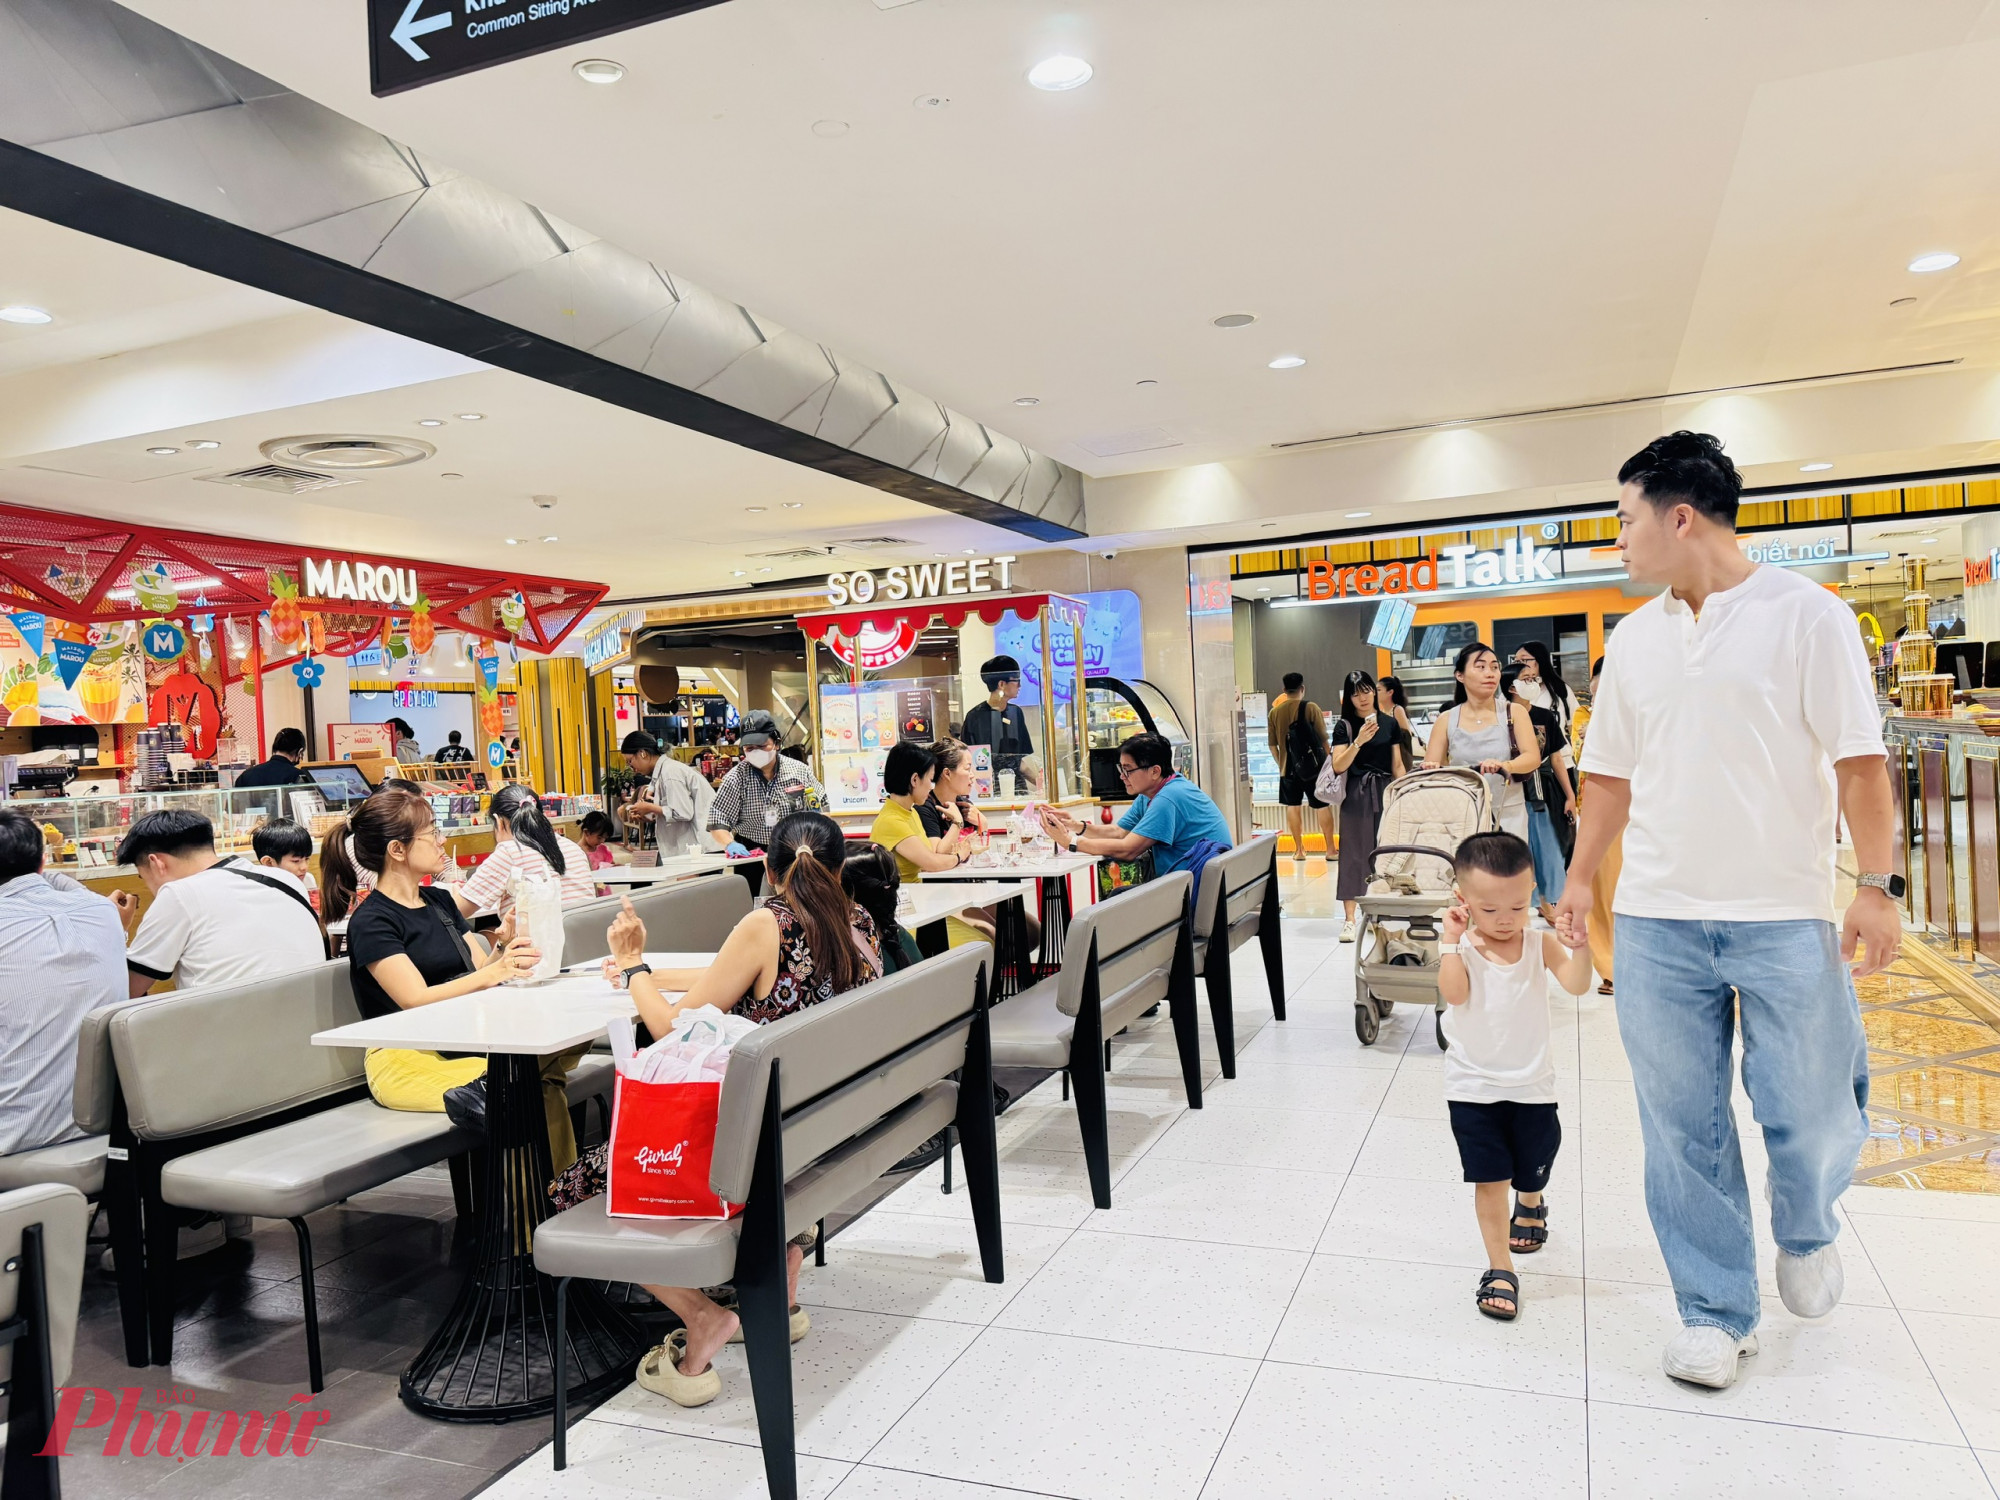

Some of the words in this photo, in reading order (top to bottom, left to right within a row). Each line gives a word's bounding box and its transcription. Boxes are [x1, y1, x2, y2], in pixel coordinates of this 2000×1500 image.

[466, 11, 526, 38] Common
[528, 0, 571, 21] Sitting
[1747, 538, 1792, 563] biết
[1798, 538, 1836, 559] nói
[306, 557, 418, 606] MAROU
[827, 571, 877, 606] SO
[887, 555, 1017, 600] SWEET
[18, 614, 40, 623] MAISON
[20, 621, 42, 631] MAROU
[61, 646, 86, 655] MAISON
[153, 631, 175, 652] M
[584, 626, 623, 669] HIGHLANDS
[60, 653, 85, 663] MAROU
[1054, 644, 1103, 664] Cady
[393, 690, 419, 708] SPICY
[421, 690, 438, 707] BOX
